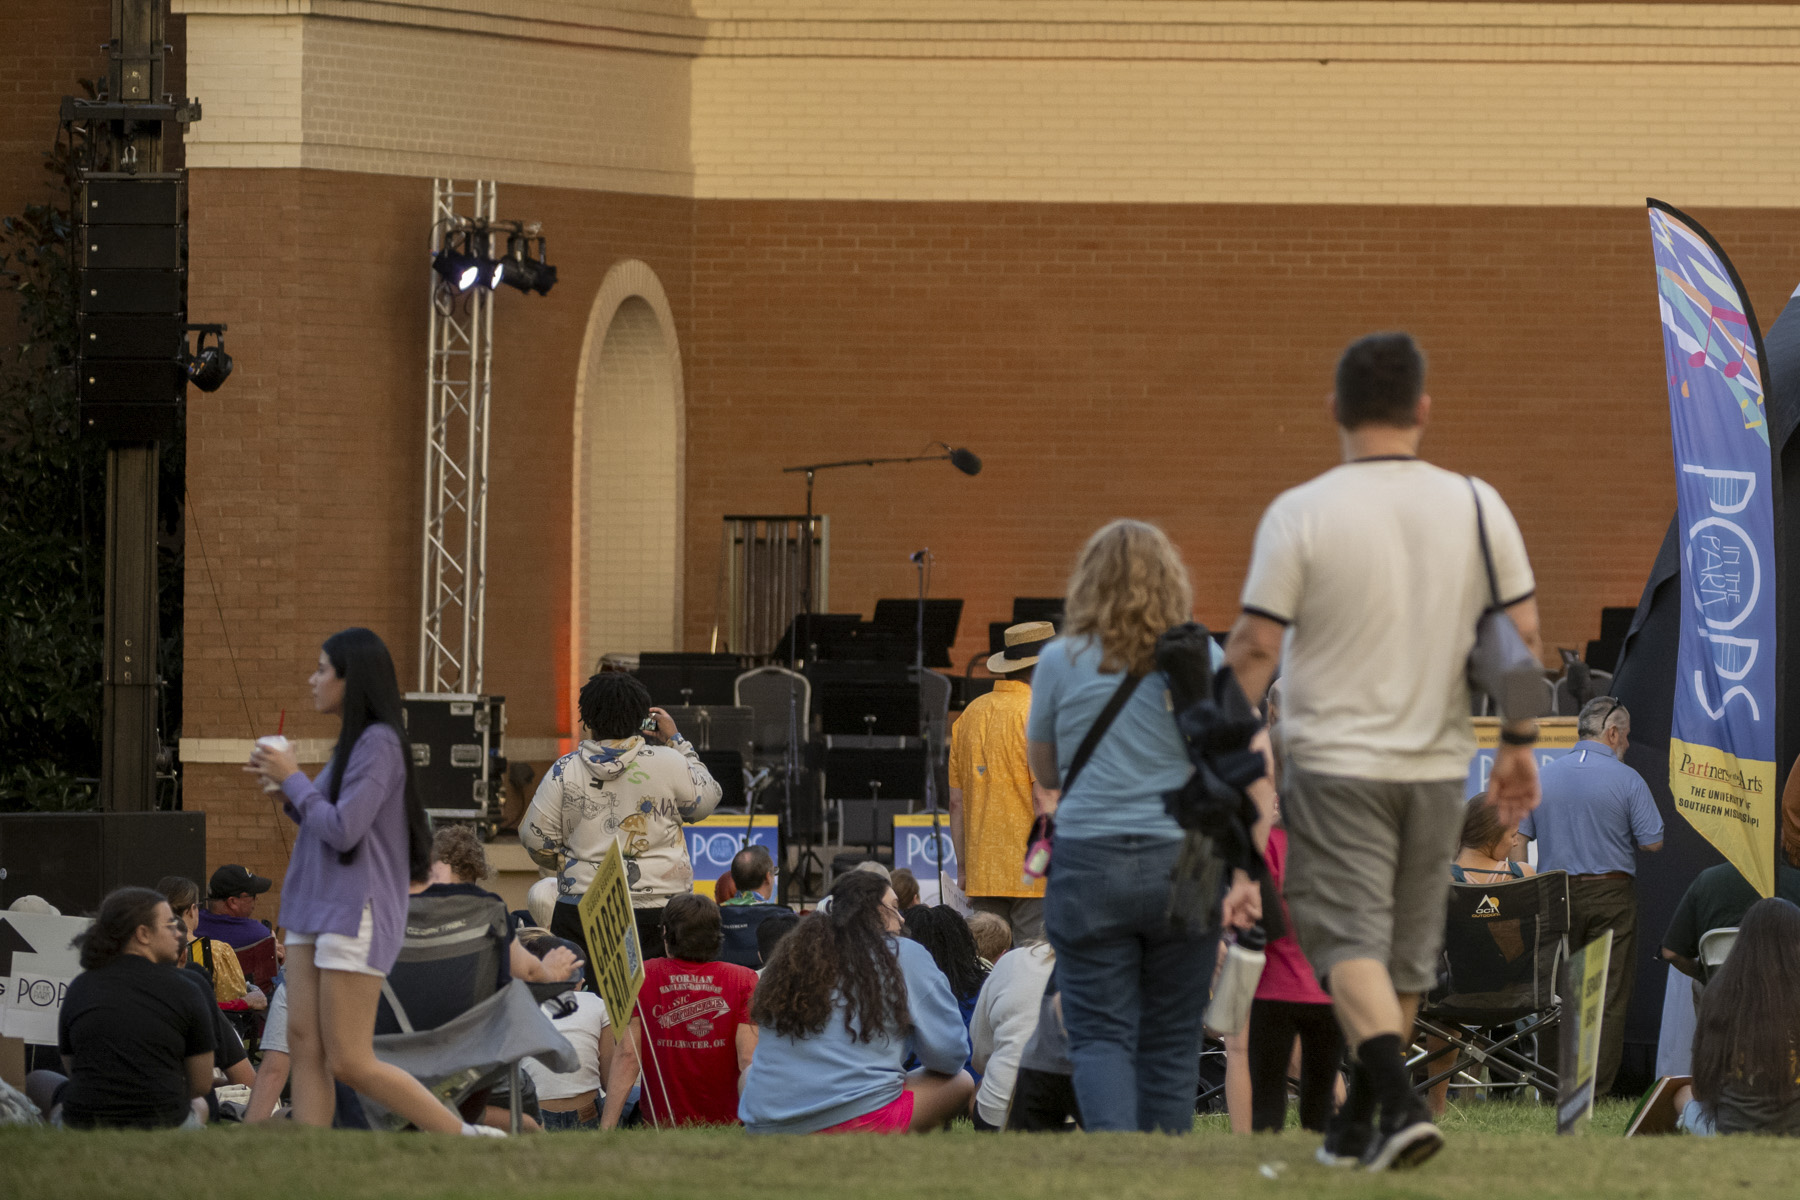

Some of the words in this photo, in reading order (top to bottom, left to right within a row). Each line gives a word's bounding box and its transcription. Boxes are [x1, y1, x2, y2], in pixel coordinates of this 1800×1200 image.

[1723, 545, 1740, 564] IN
[1701, 535, 1729, 606] PARK
[1683, 463, 1760, 721] POPS
[1725, 572, 1741, 603] THE
[1680, 753, 1729, 781] Partners
[1738, 769, 1763, 792] Arts
[1679, 798, 1723, 816] SOUTHERN
[1691, 786, 1706, 798] THE
[590, 876, 630, 977] CAREER
[602, 954, 630, 1029] FAIR
[669, 974, 714, 984] FORMAN
[713, 1039, 726, 1048] OK
